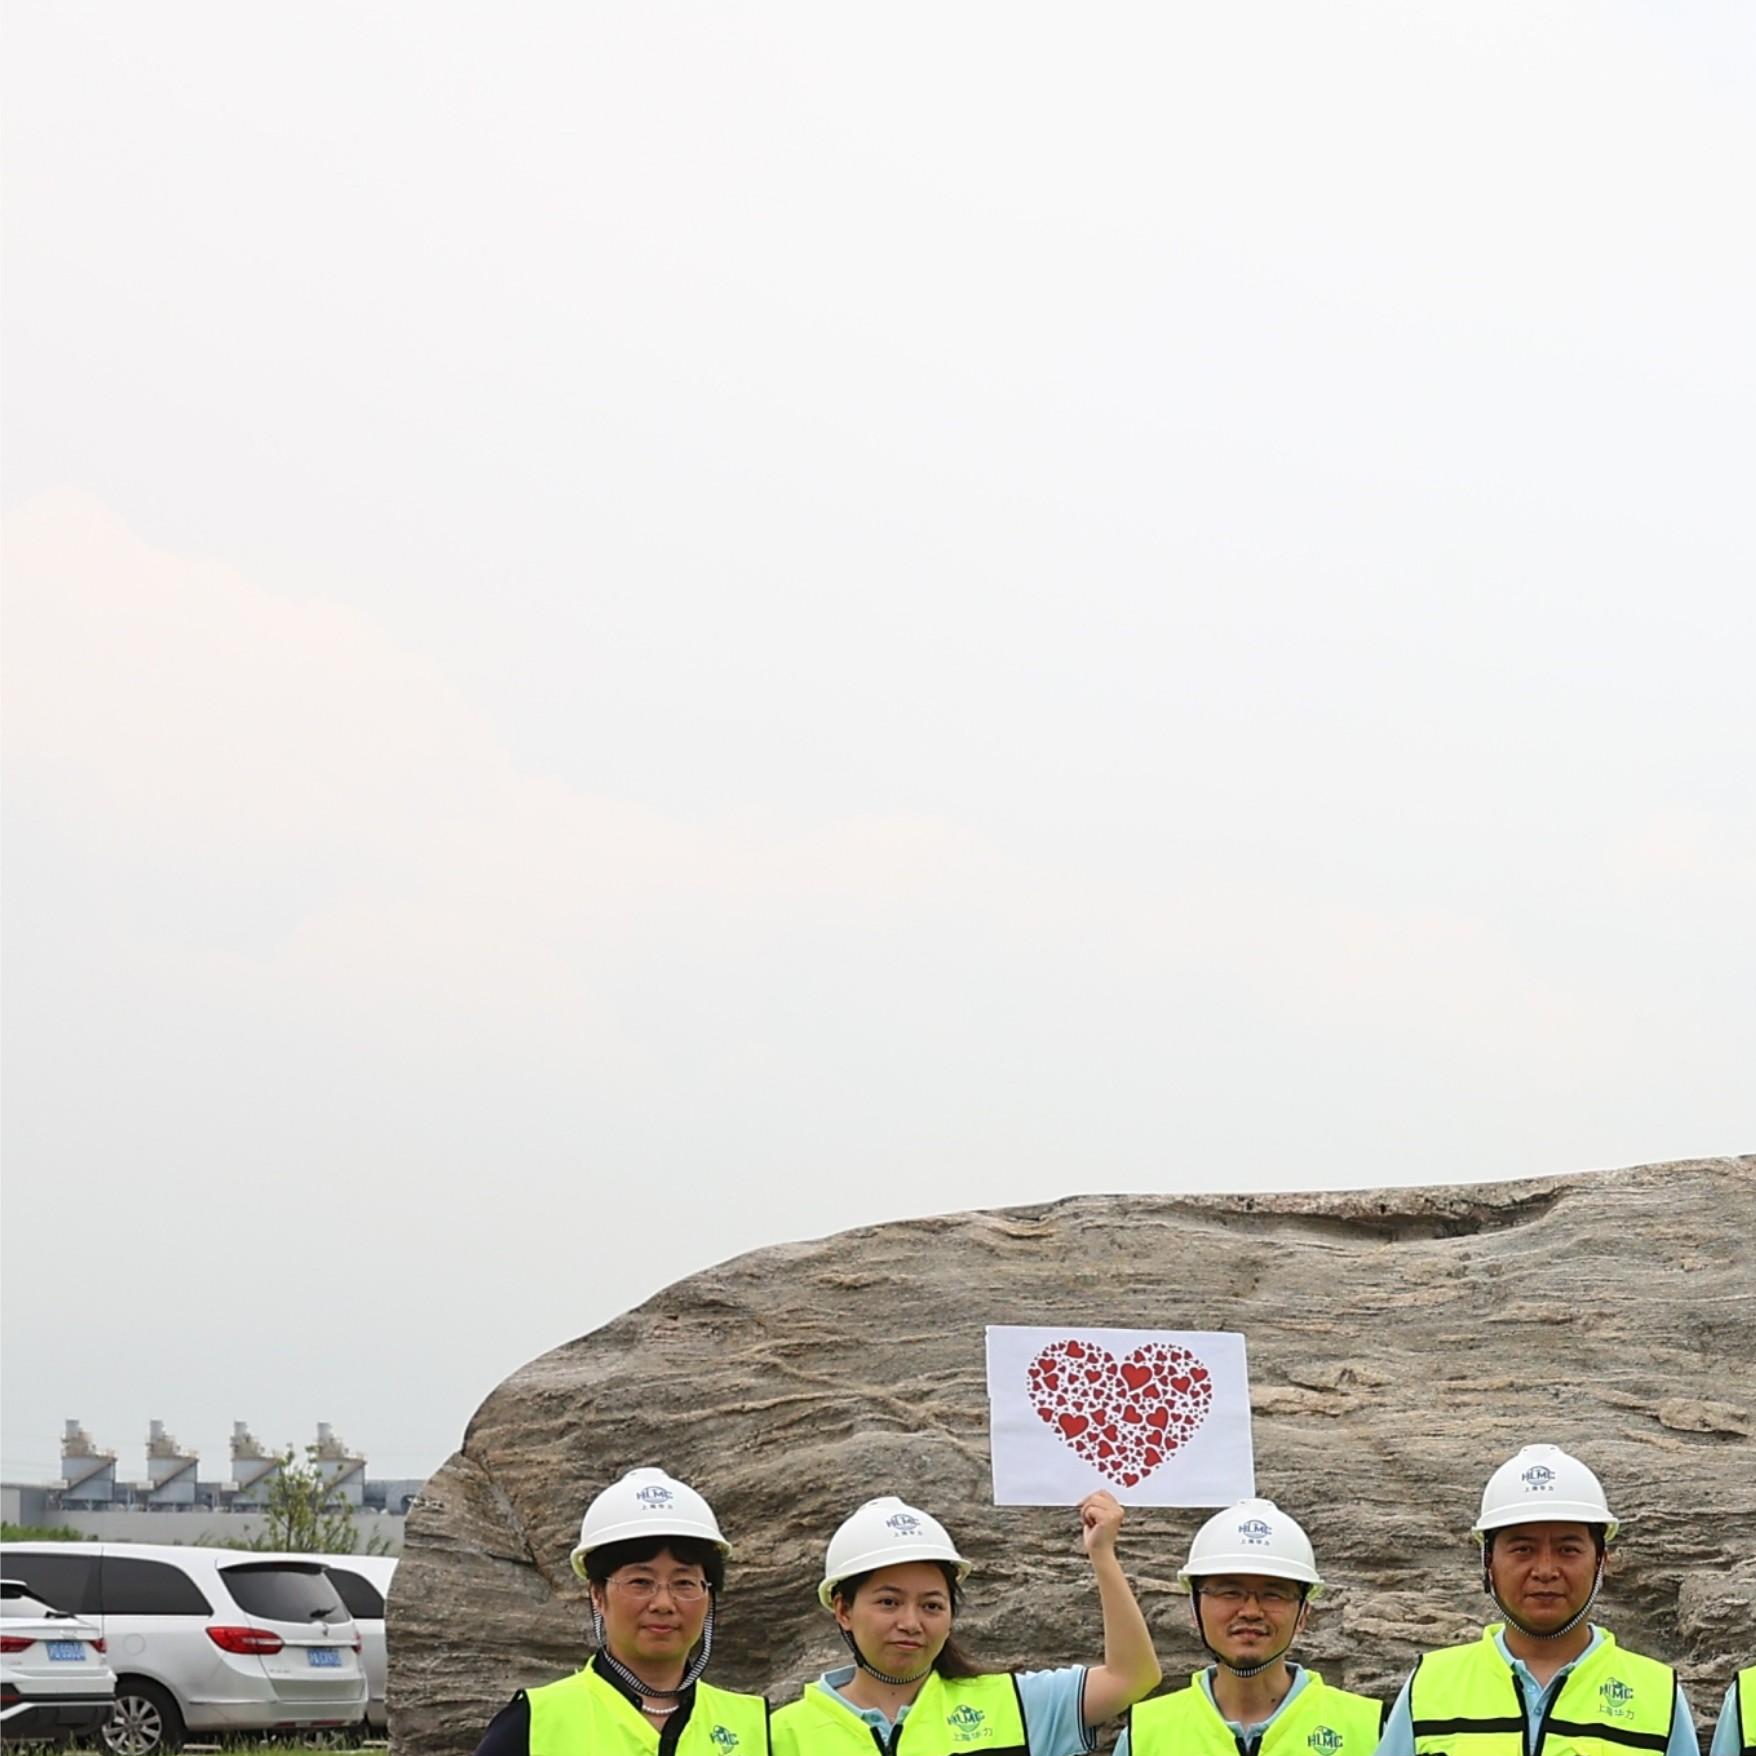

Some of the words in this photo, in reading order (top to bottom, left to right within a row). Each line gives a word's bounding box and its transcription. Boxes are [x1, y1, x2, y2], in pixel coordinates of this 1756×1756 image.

[1522, 1470, 1555, 1481] HLMC
[1239, 1524, 1272, 1535] HLMC
[947, 1709, 985, 1725] HLMC
[1308, 1733, 1343, 1748] HLMC
